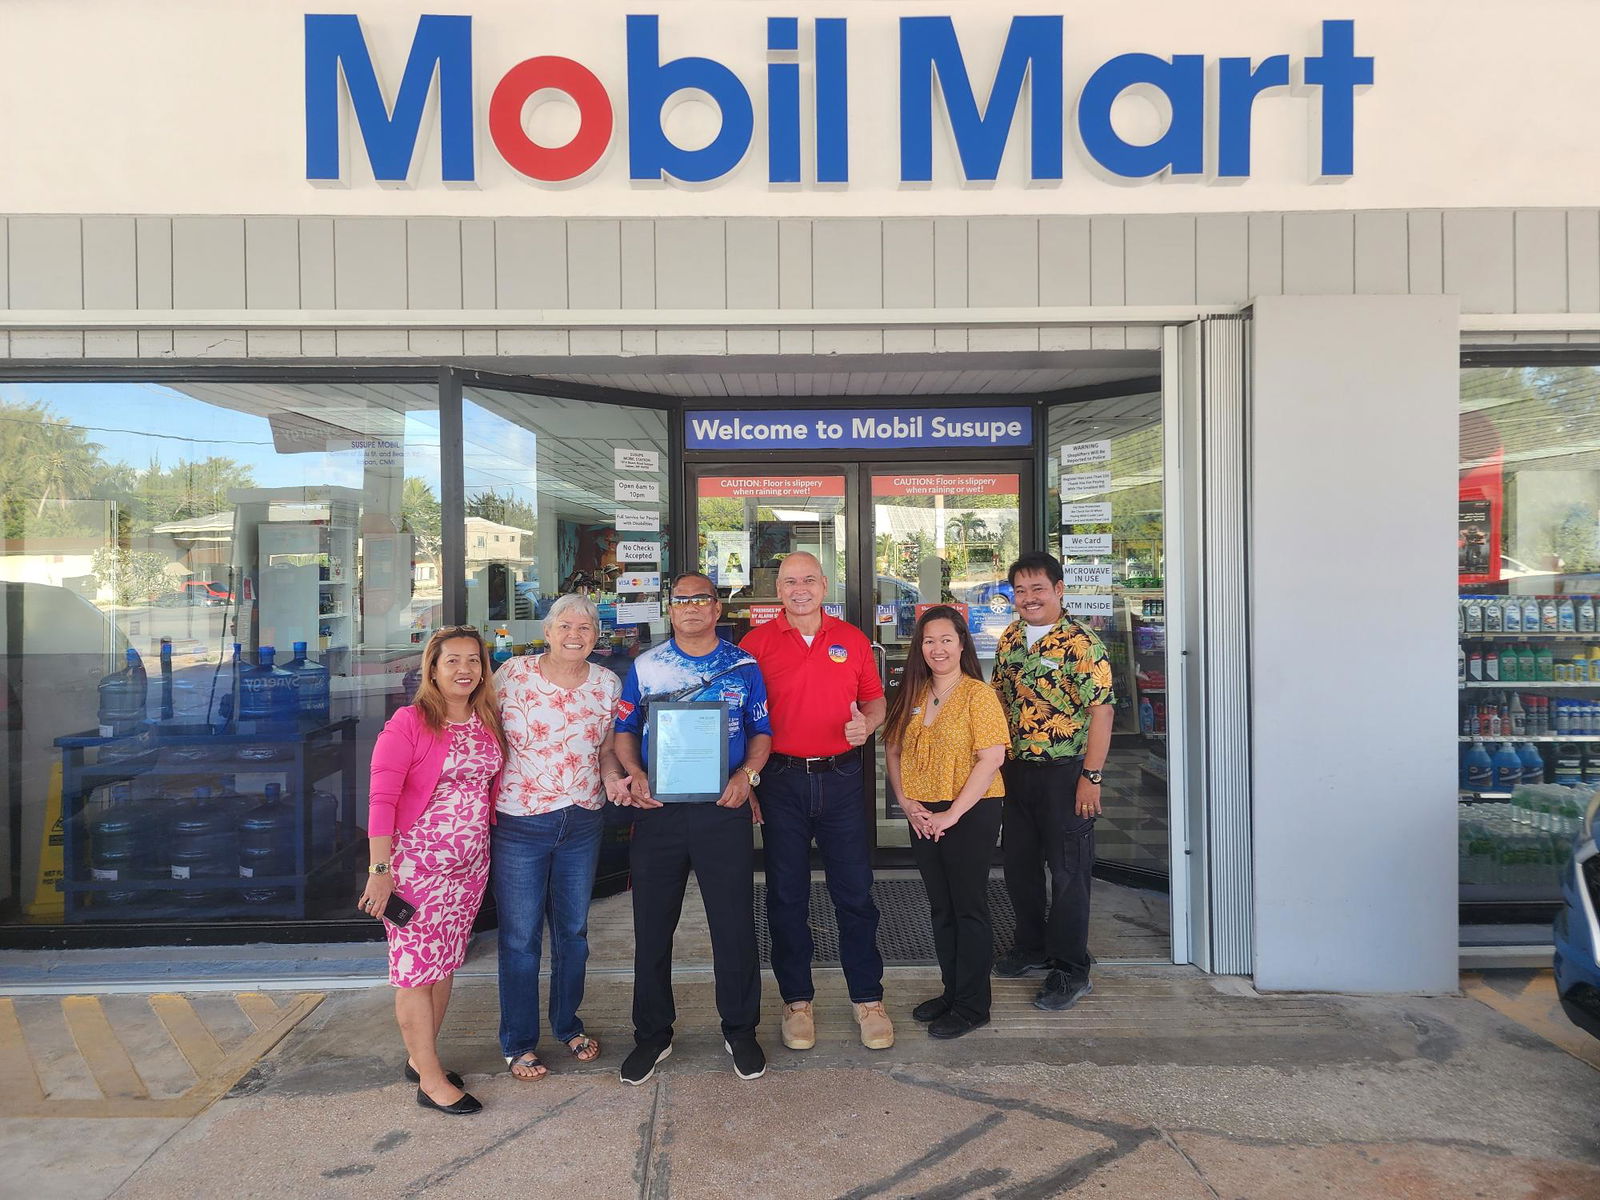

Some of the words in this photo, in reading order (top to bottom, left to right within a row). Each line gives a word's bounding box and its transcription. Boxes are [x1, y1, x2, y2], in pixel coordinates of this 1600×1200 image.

[305, 14, 849, 183] Mobil
[900, 15, 1374, 182] Mart
[691, 417, 808, 440] Welcome
[815, 420, 844, 440] to
[851, 415, 923, 439] Mobil
[931, 416, 1022, 443] Susupe
[351, 441, 376, 449] SUSUPE
[377, 440, 400, 449] MOBIL
[618, 482, 635, 490] Open
[720, 479, 761, 487] CAUTION:
[784, 479, 791, 487] is
[791, 479, 823, 488] slippery
[893, 478, 935, 486] CAUTION:
[936, 478, 956, 486] Floor
[964, 477, 997, 486] slippery
[755, 488, 782, 496] raining
[792, 487, 811, 495] wet!
[905, 486, 927, 494] when
[928, 486, 955, 495] raining
[965, 485, 984, 493] wet!
[629, 491, 646, 499] 10pm
[624, 552, 653, 560] Accepted
[725, 553, 744, 573] A
[1064, 567, 1111, 575] MICROWAVE
[824, 605, 842, 614] Pull
[877, 604, 895, 614] Pull
[1065, 601, 1082, 609] ATM
[1084, 602, 1111, 610] INSIDE
